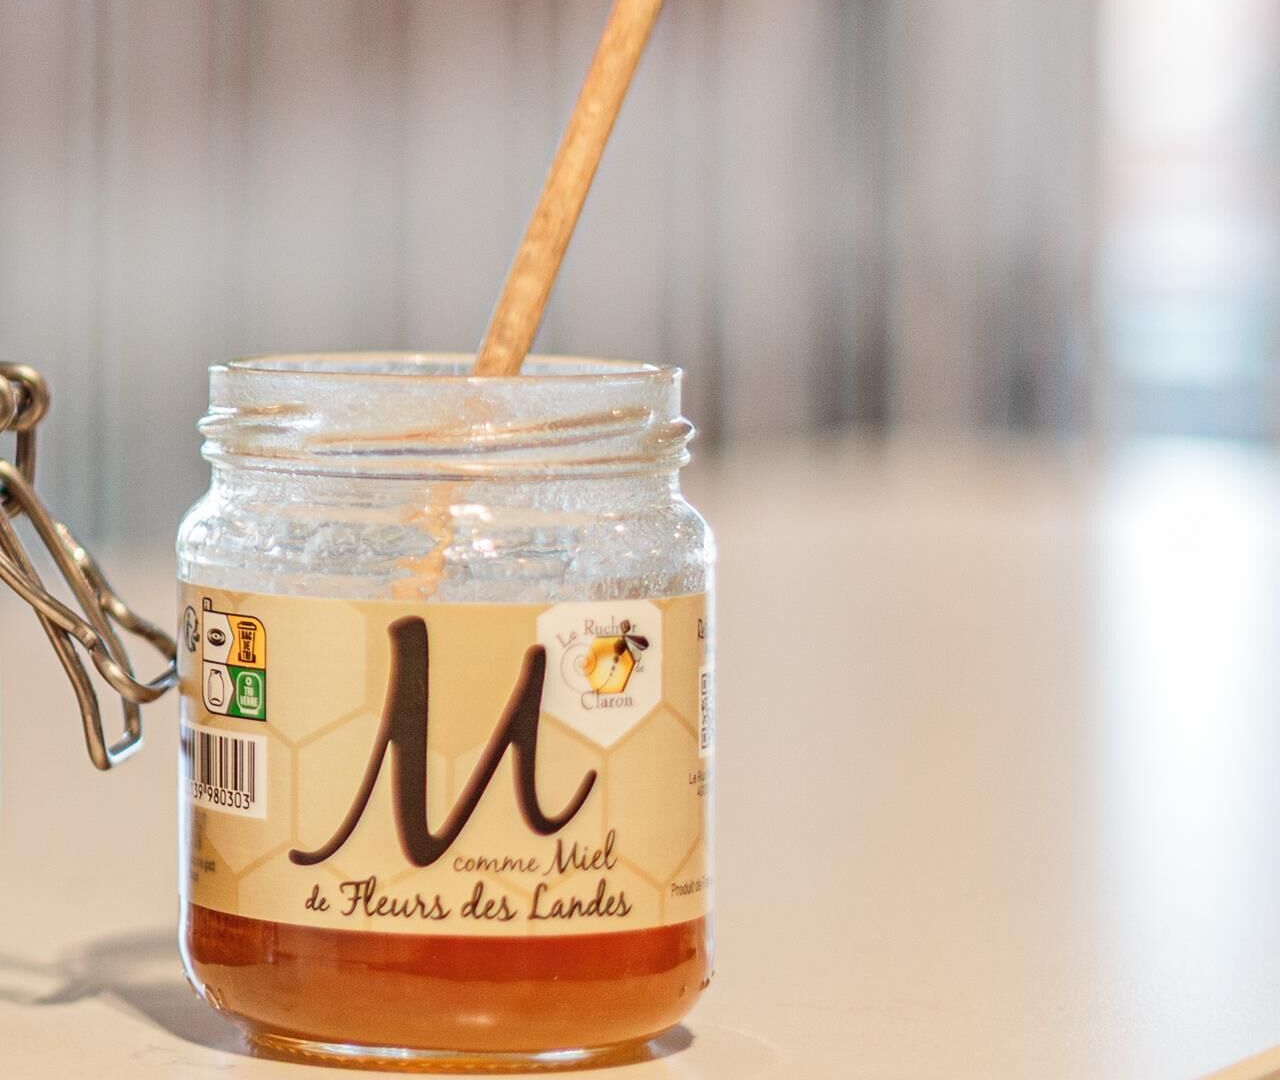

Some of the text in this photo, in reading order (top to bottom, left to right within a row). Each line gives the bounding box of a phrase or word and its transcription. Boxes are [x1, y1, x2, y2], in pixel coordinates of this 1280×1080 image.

[556, 616, 637, 648] Le Ruchr
[581, 690, 633, 710] Claron
[288, 615, 597, 868] M
[207, 787, 250, 809] 980303
[453, 828, 617, 876] comme Miel
[305, 876, 633, 922] de Fleurs des Landes
